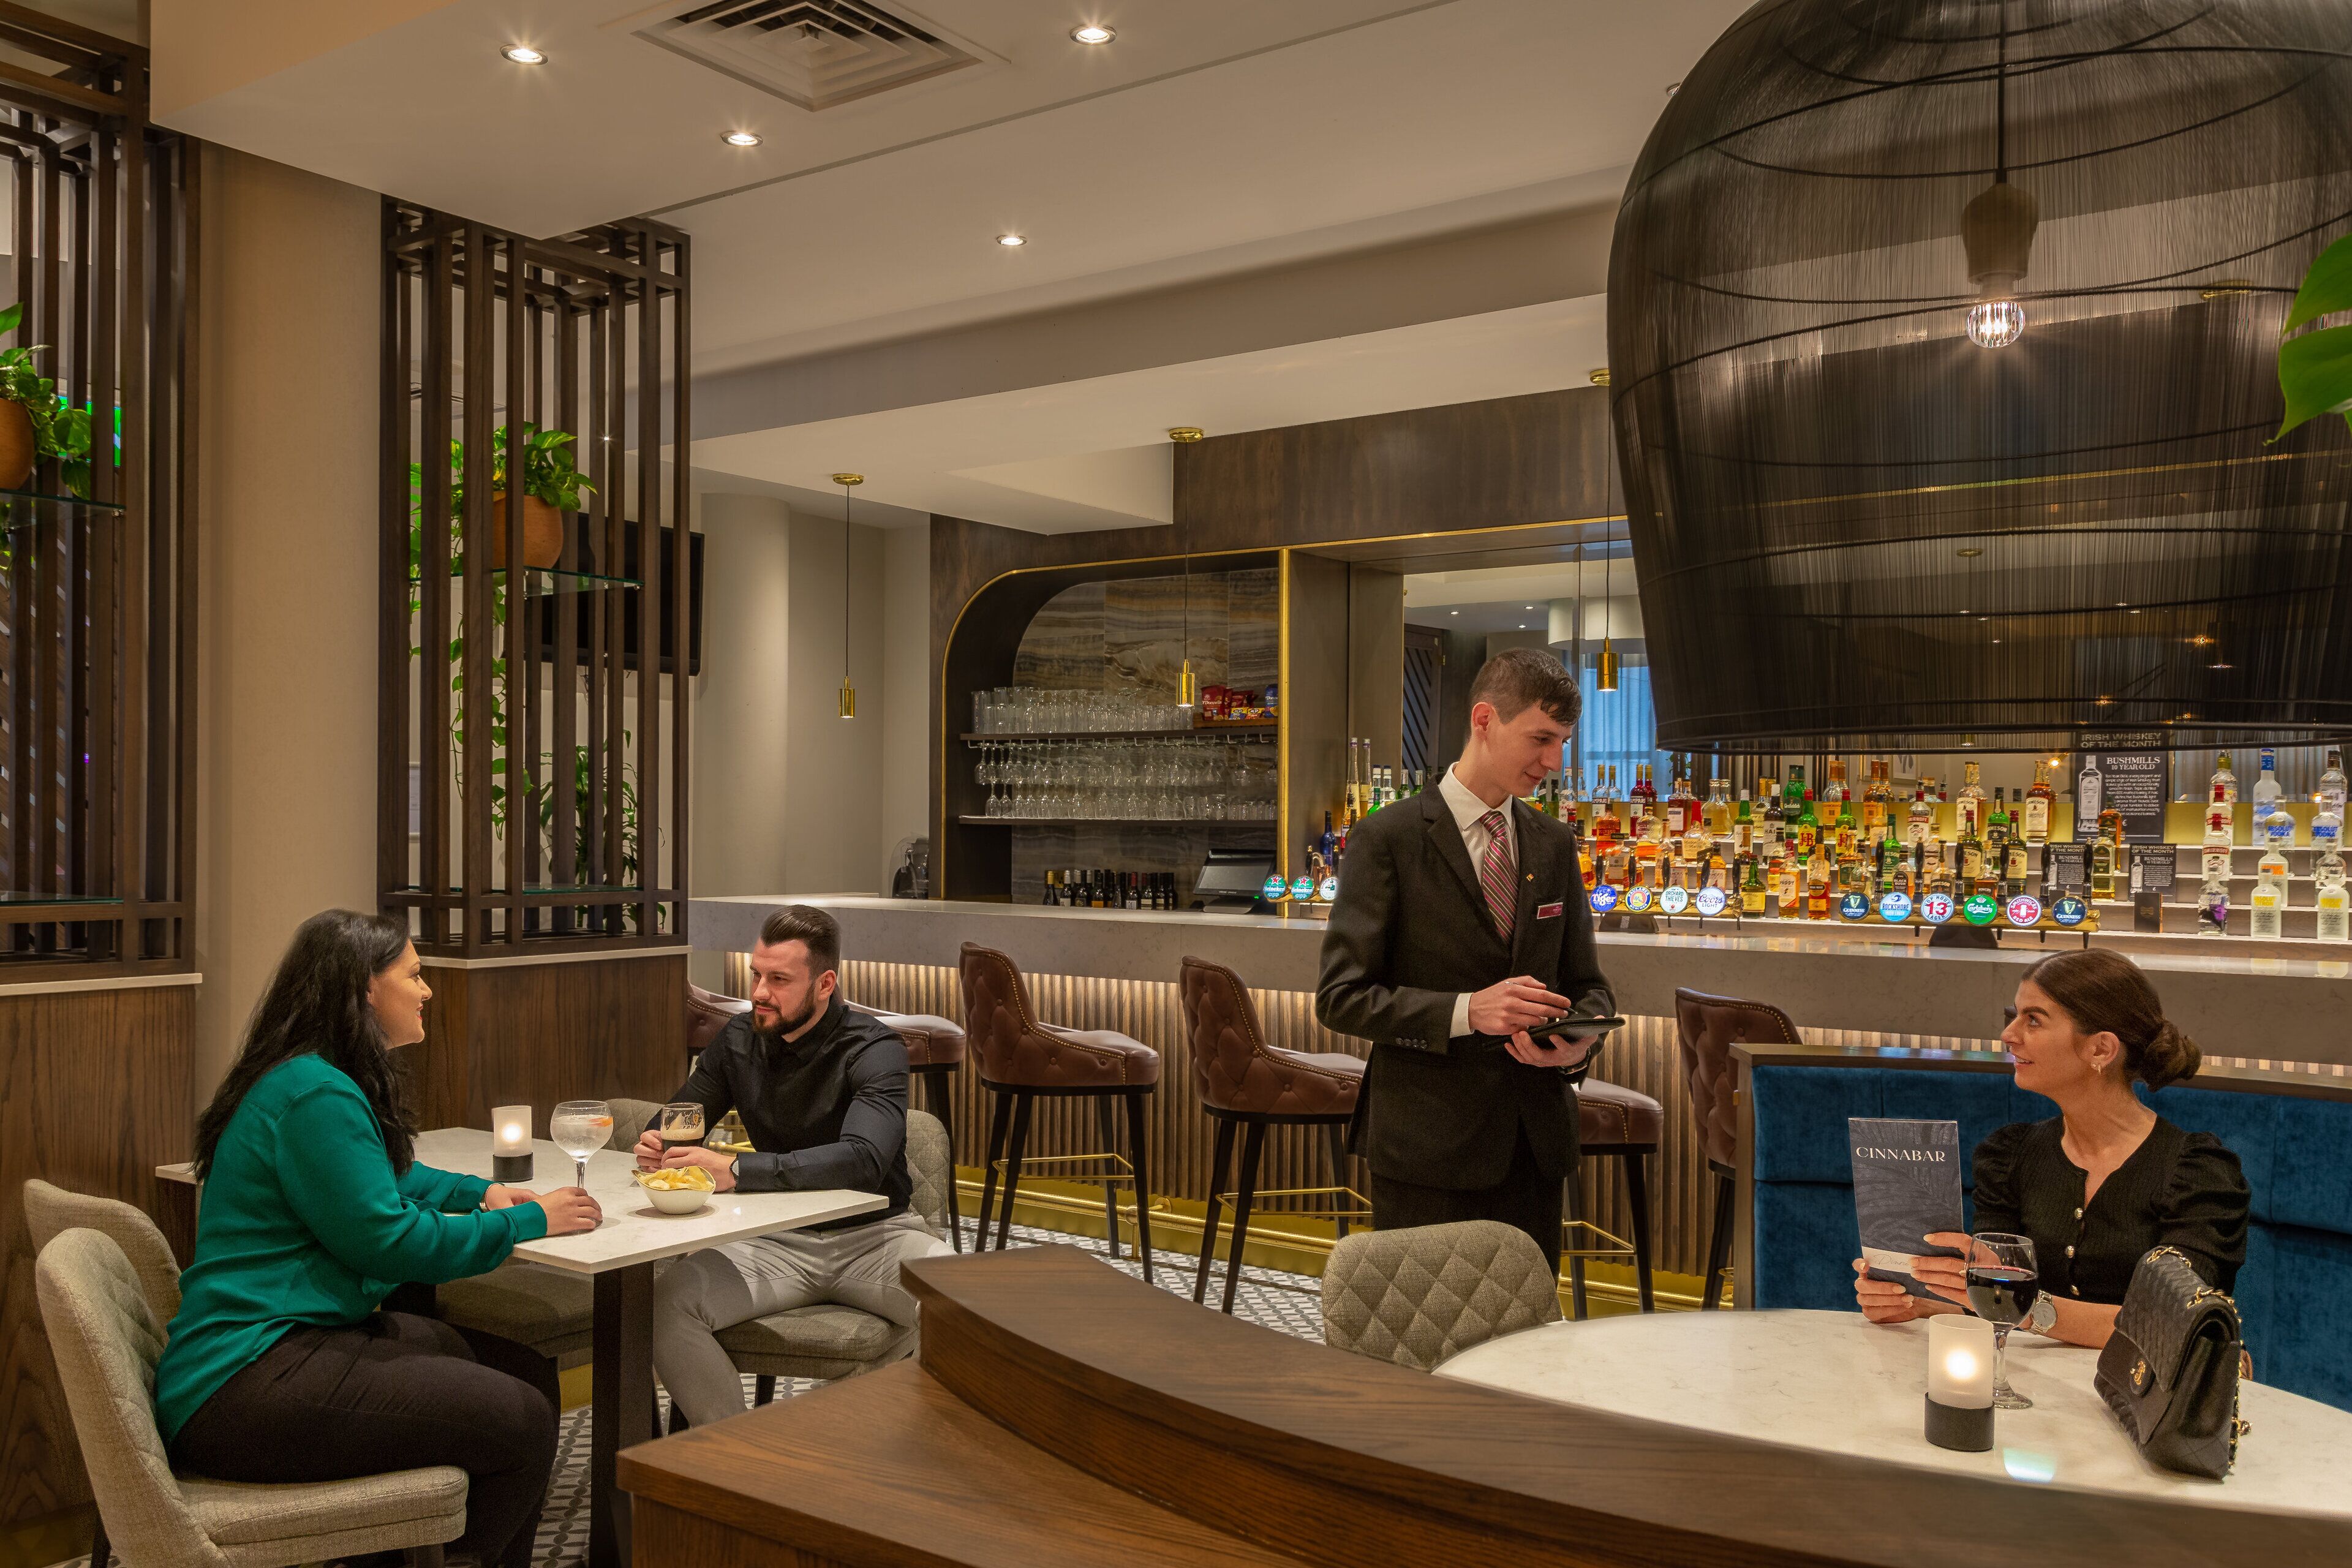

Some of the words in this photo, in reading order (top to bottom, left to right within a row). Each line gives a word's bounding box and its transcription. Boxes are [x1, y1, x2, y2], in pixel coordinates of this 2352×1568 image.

[1628, 887, 1649, 897] PAULANER
[1593, 893, 1616, 906] Tiger
[1698, 894, 1723, 903] Coors
[1926, 901, 1948, 916] 13
[1967, 903, 1993, 914] Carlsberg
[1856, 1147, 1946, 1162] CINNABAR
